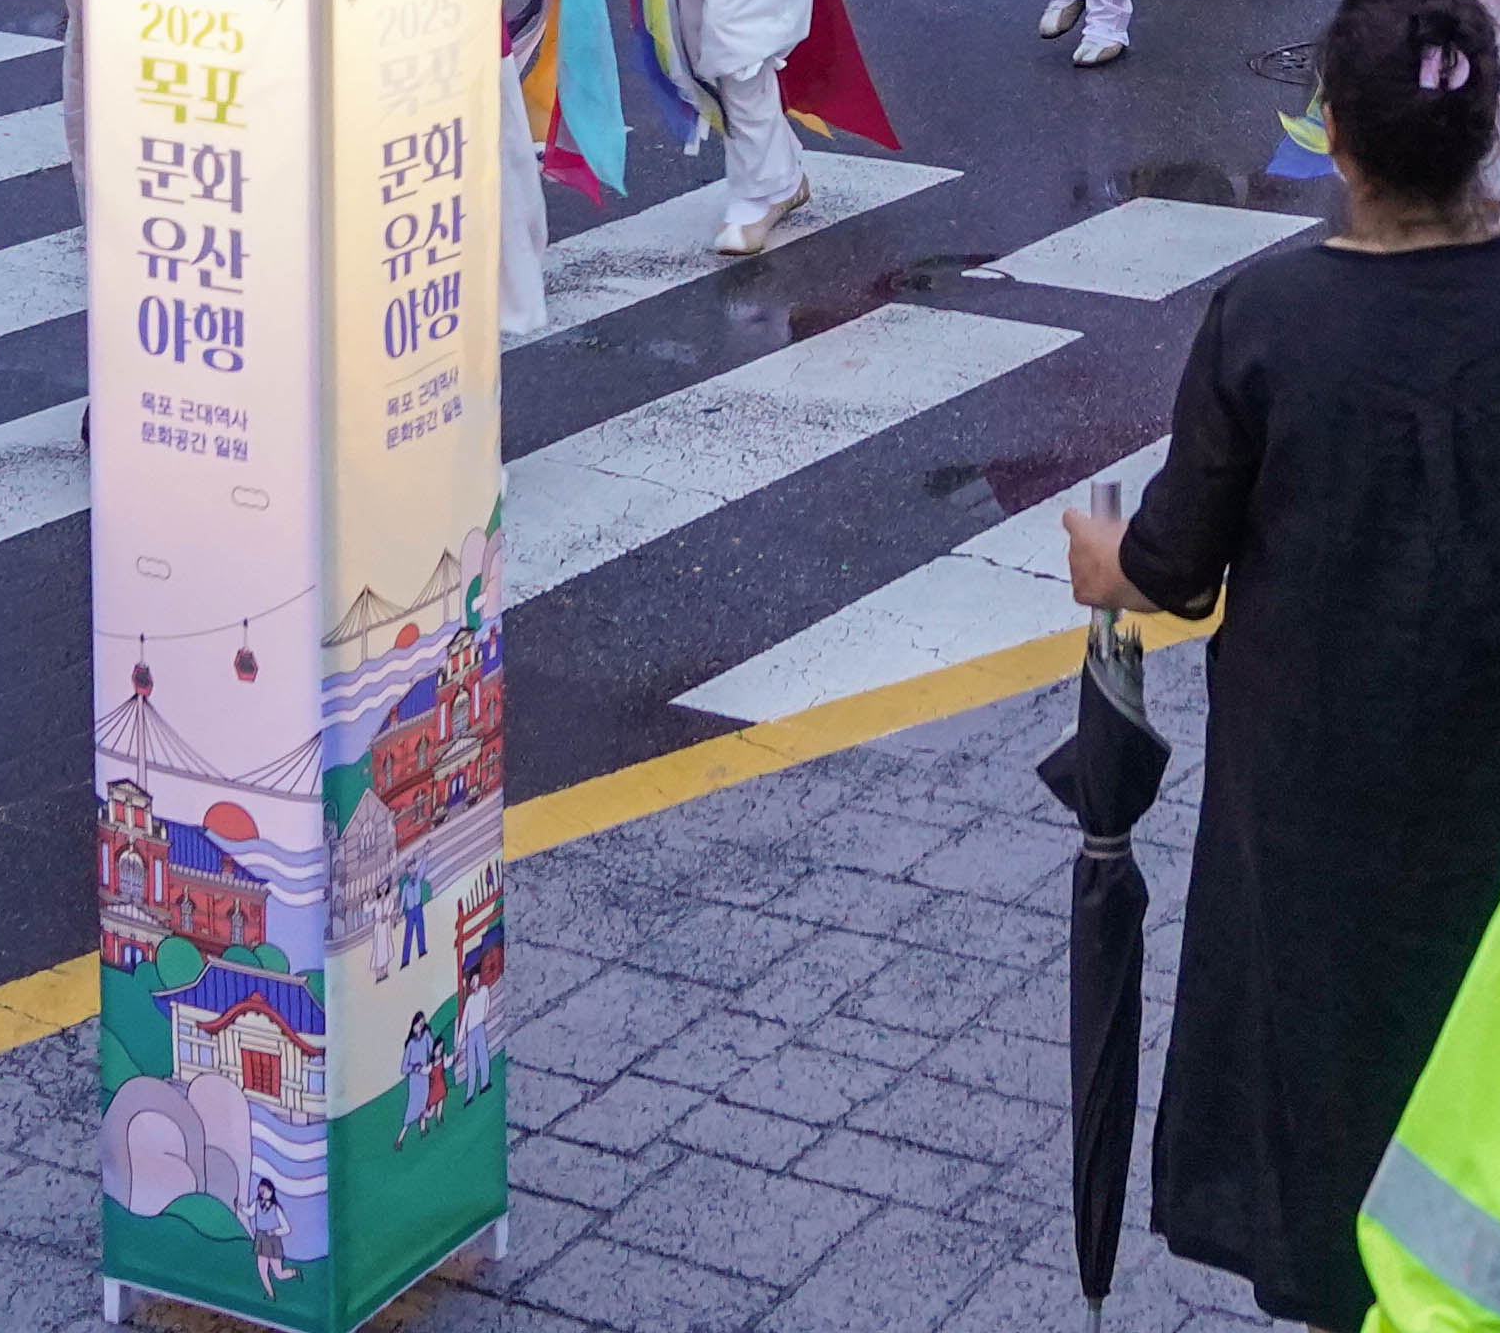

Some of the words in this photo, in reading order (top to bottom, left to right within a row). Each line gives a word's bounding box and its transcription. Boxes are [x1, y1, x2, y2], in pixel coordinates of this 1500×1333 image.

[139, 0, 245, 55] 2025
[136, 56, 246, 129] 목포
[378, 43, 465, 117] 목포
[136, 135, 249, 214] 문화
[378, 116, 468, 206] 문화
[136, 215, 250, 296] 유산
[382, 201, 467, 284] 유산
[137, 294, 245, 374] 야행
[384, 271, 463, 360] 야행
[140, 390, 174, 418] 목포
[179, 394, 249, 433] 근대역사
[385, 411, 437, 450] 문화공간
[441, 393, 463, 423] 일원
[386, 389, 414, 416] 목포
[418, 366, 460, 406] 근대역사
[140, 420, 206, 456] 문화공간
[214, 432, 249, 462] 일원
